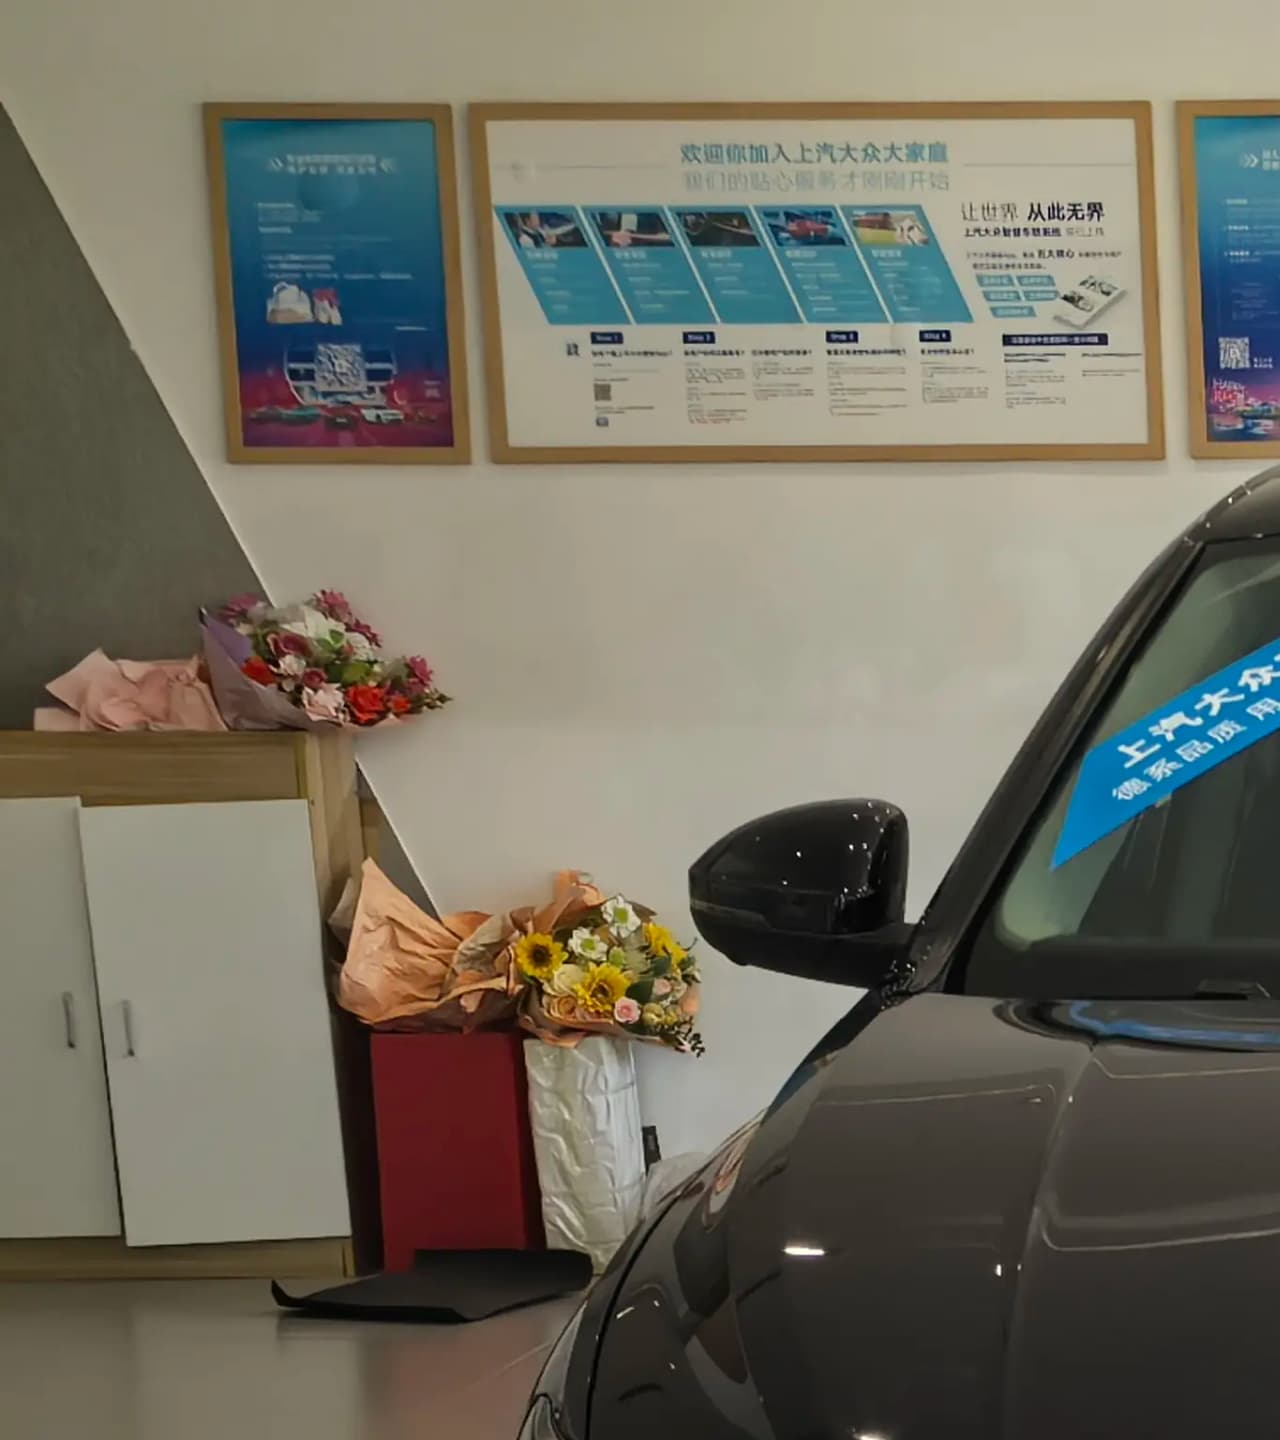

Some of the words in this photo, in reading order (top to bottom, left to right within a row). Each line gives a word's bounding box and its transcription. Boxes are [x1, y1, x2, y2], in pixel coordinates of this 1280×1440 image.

[1027, 201, 1106, 223] 从此无界
[1112, 719, 1247, 801] 德系品质
